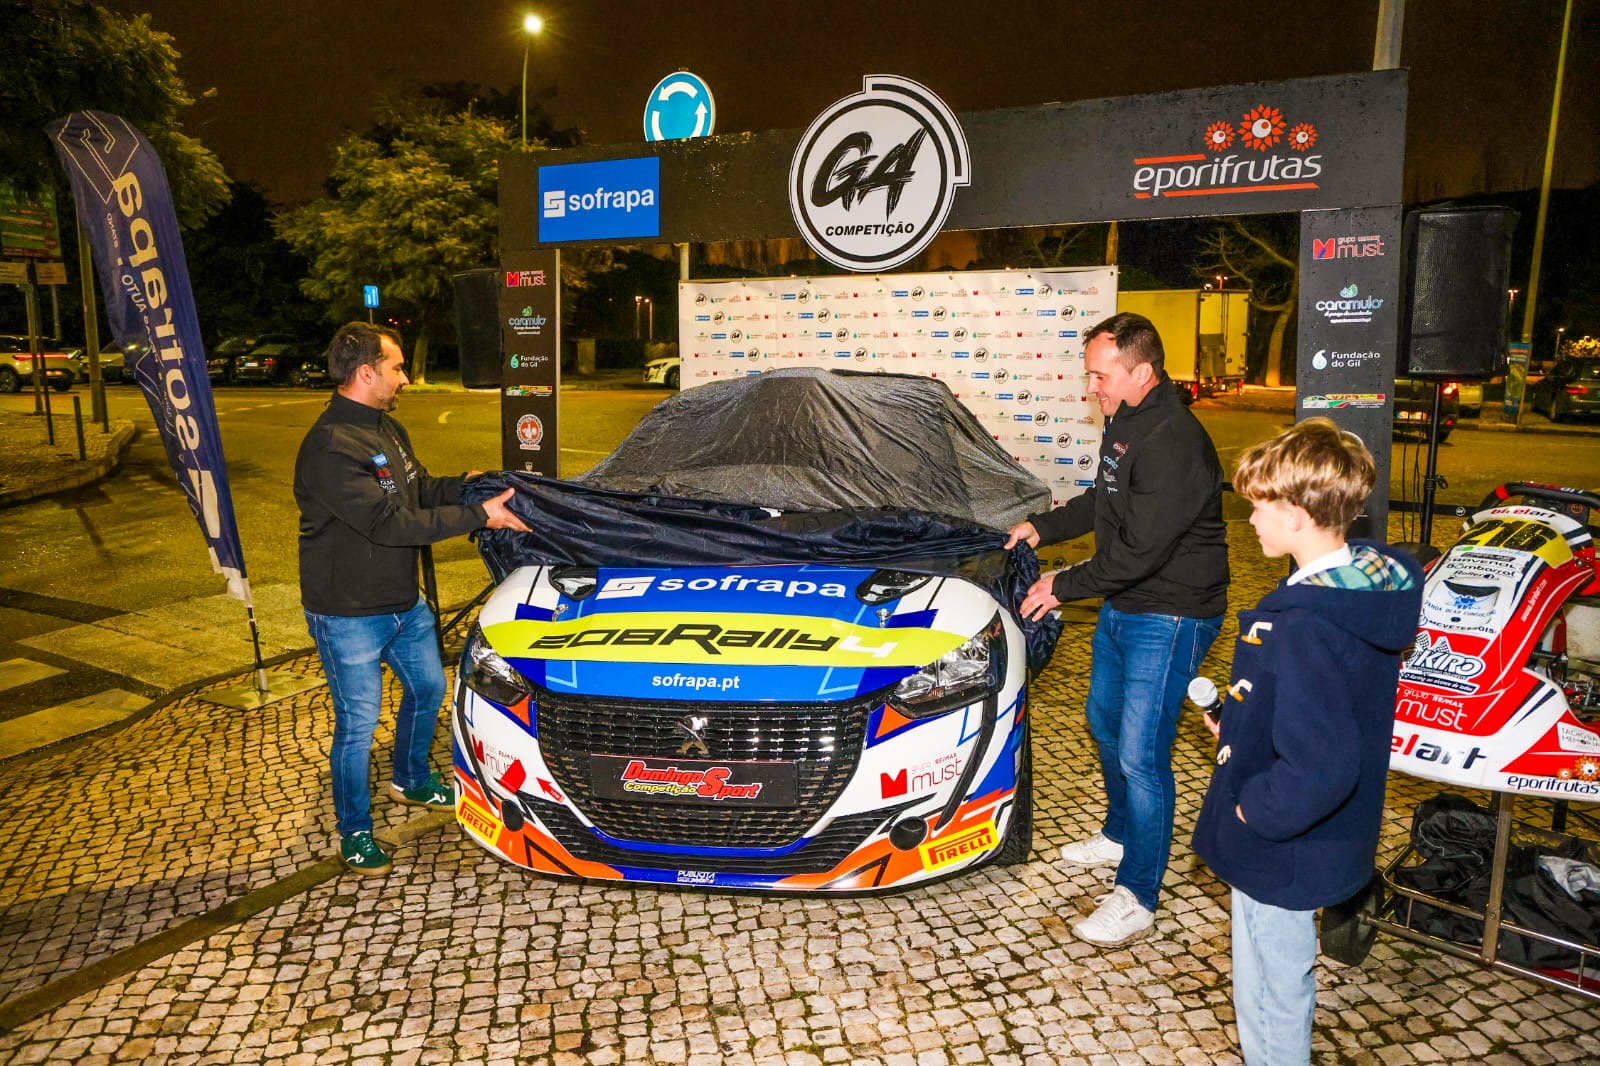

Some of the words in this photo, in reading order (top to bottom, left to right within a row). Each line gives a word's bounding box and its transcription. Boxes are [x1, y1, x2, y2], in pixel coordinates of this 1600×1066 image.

[810, 126, 928, 223] G4
[1133, 154, 1323, 196] eporifrutas
[568, 187, 655, 212] sofrapa
[825, 221, 915, 237] COMPETIÇÃO
[1336, 241, 1385, 258] must
[519, 274, 546, 287] must
[1315, 295, 1384, 311] caramulo
[520, 355, 549, 363] Fundação
[1331, 351, 1381, 360] Fundação
[1331, 360, 1344, 368] do
[1347, 360, 1361, 368] Gil
[656, 575, 846, 598] sofrapa
[1411, 648, 1484, 677] KIRO
[652, 673, 741, 691] sofrapa.pt
[1403, 688, 1429, 700] grupo
[1395, 698, 1468, 731] must
[912, 757, 962, 793] must
[624, 781, 698, 796] Competição
[1507, 775, 1599, 794] eporifrutas
[459, 800, 497, 840] PIRELLI
[927, 827, 992, 866] PIRELLI
